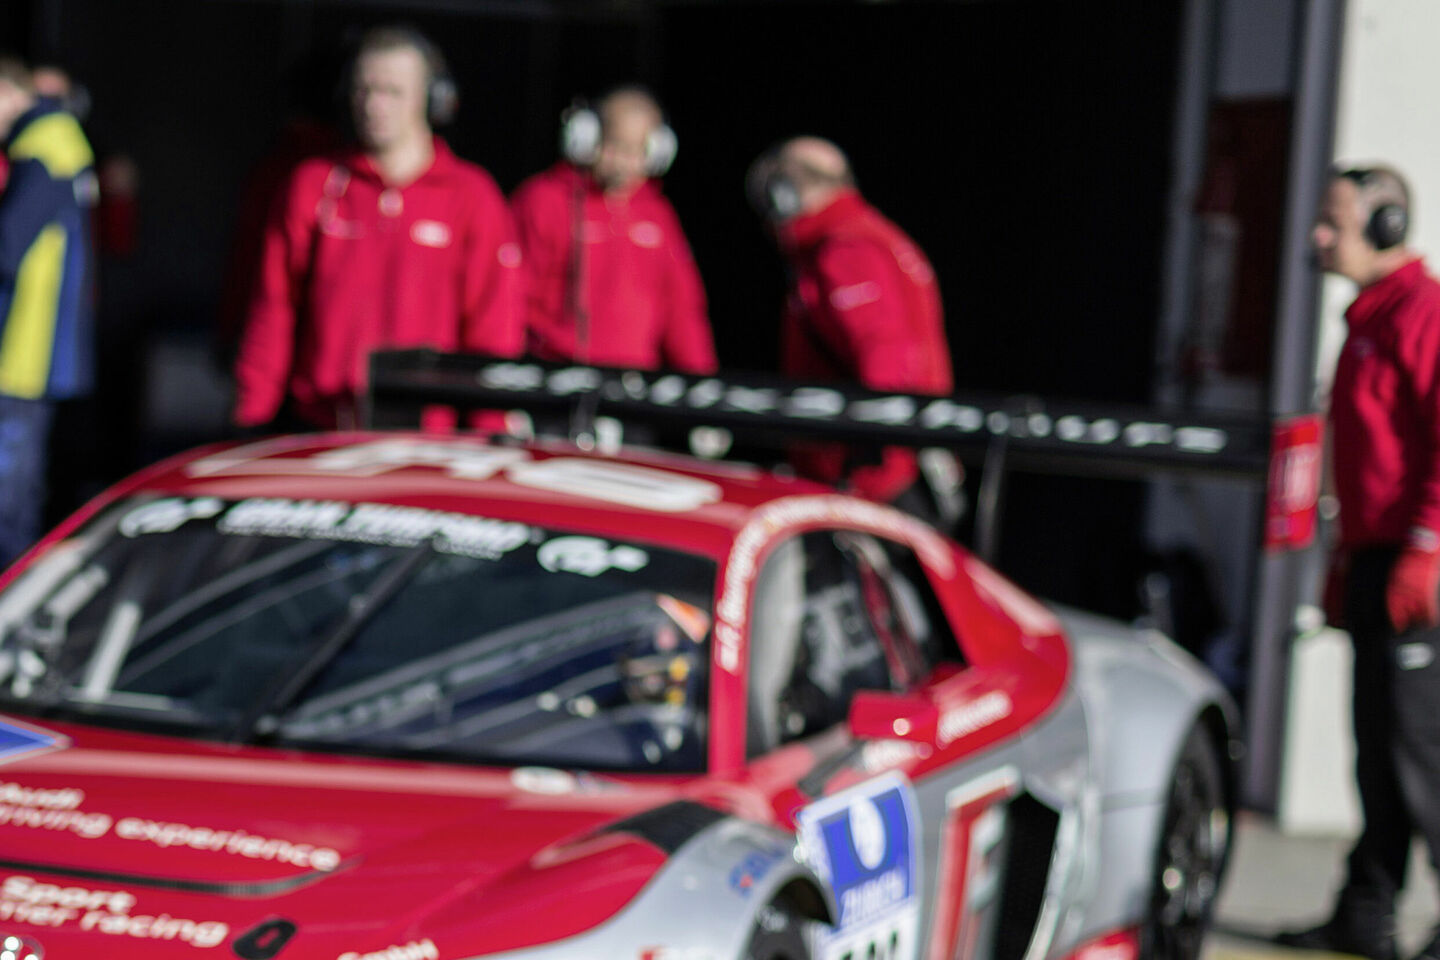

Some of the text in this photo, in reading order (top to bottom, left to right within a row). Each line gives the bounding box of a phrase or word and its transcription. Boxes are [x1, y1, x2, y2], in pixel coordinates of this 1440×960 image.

[115, 817, 340, 871] experience
[0, 875, 136, 913] Sport
[80, 910, 229, 948] racing
